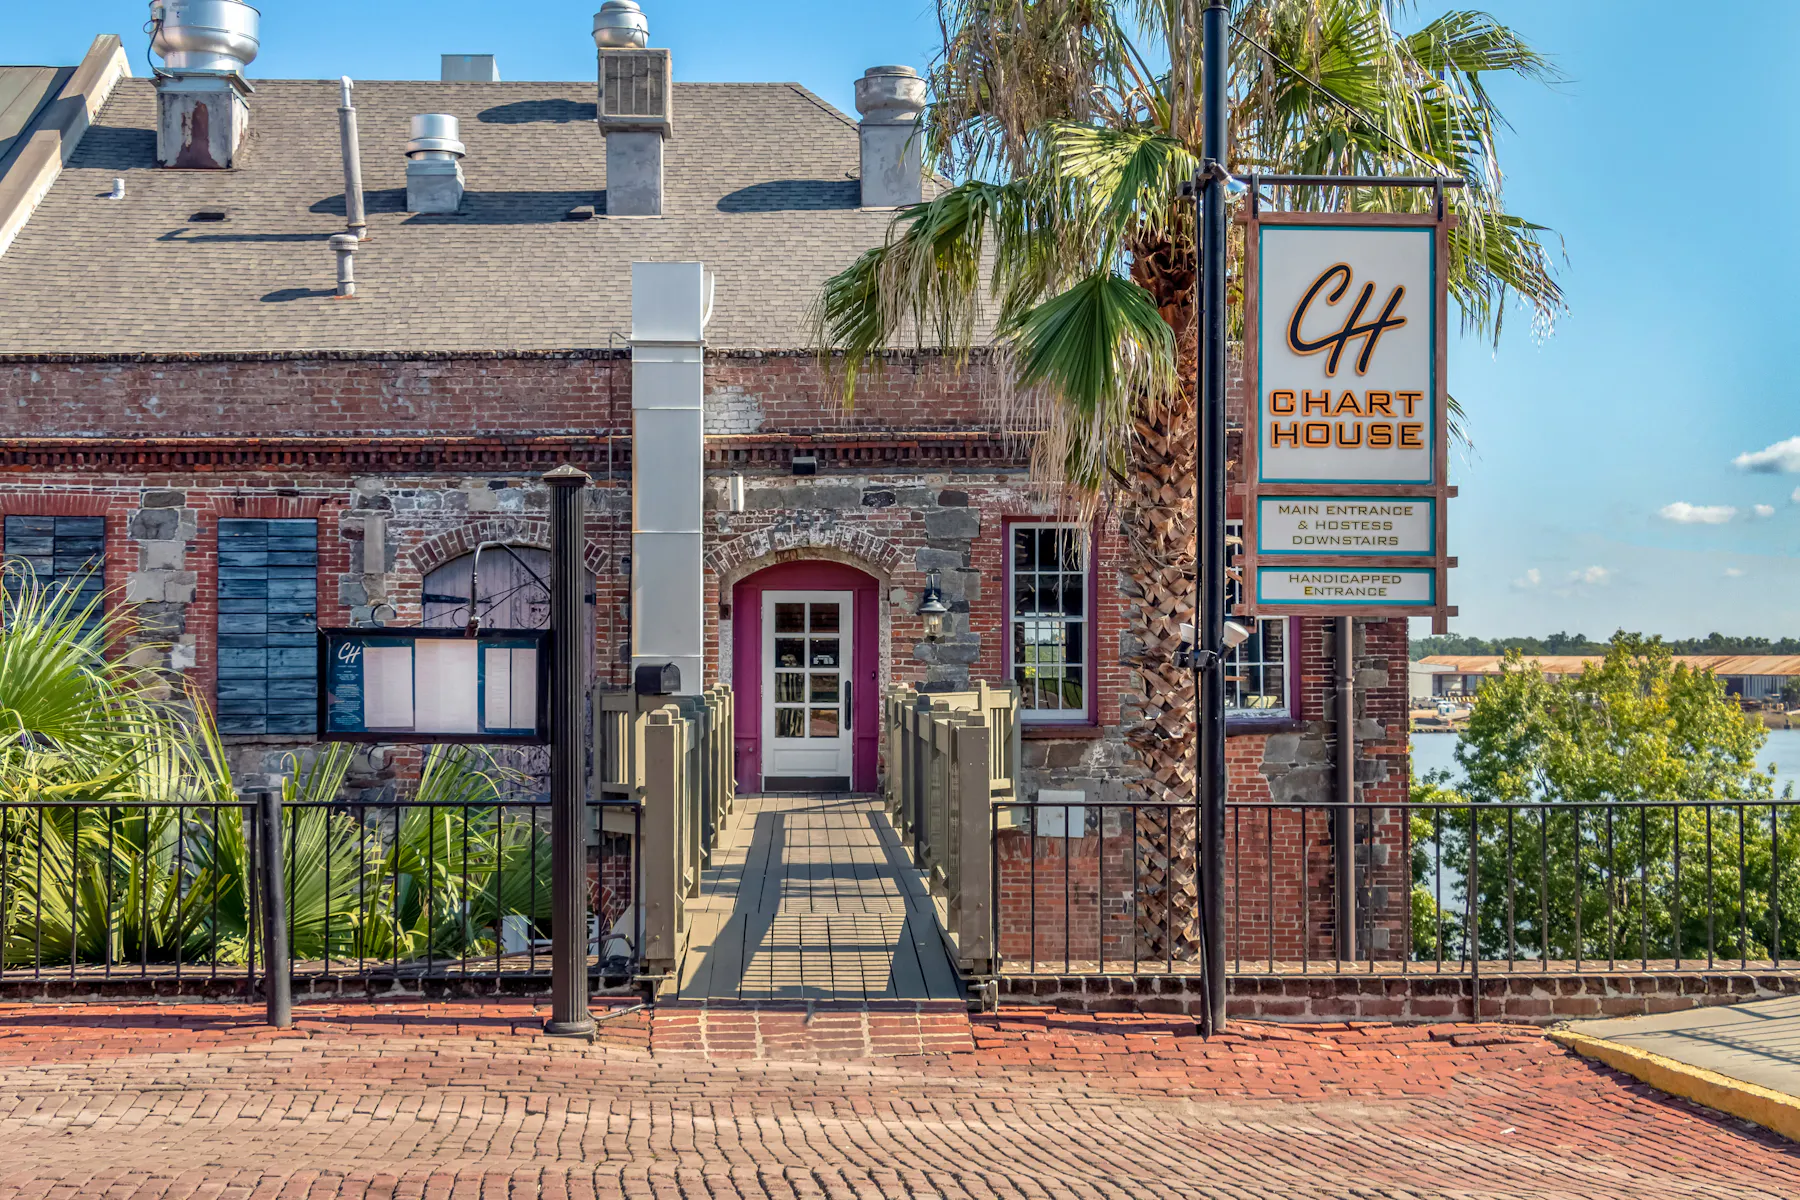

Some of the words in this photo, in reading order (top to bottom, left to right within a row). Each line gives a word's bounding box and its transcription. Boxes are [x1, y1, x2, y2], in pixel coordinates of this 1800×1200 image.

[1287, 262, 1408, 376] CH
[1269, 389, 1424, 418] CHART
[1271, 421, 1424, 449] HOUSE
[1278, 504, 1319, 515] MAIN
[1326, 505, 1413, 516] ENTRANCE
[1297, 520, 1308, 530] &
[1315, 520, 1393, 531] HOSTESS
[1292, 535, 1399, 546] DOWNSTAIRS
[1289, 574, 1402, 585] HANDICAPPED
[1304, 586, 1387, 597] ENTRANCE
[338, 642, 361, 664] CH
